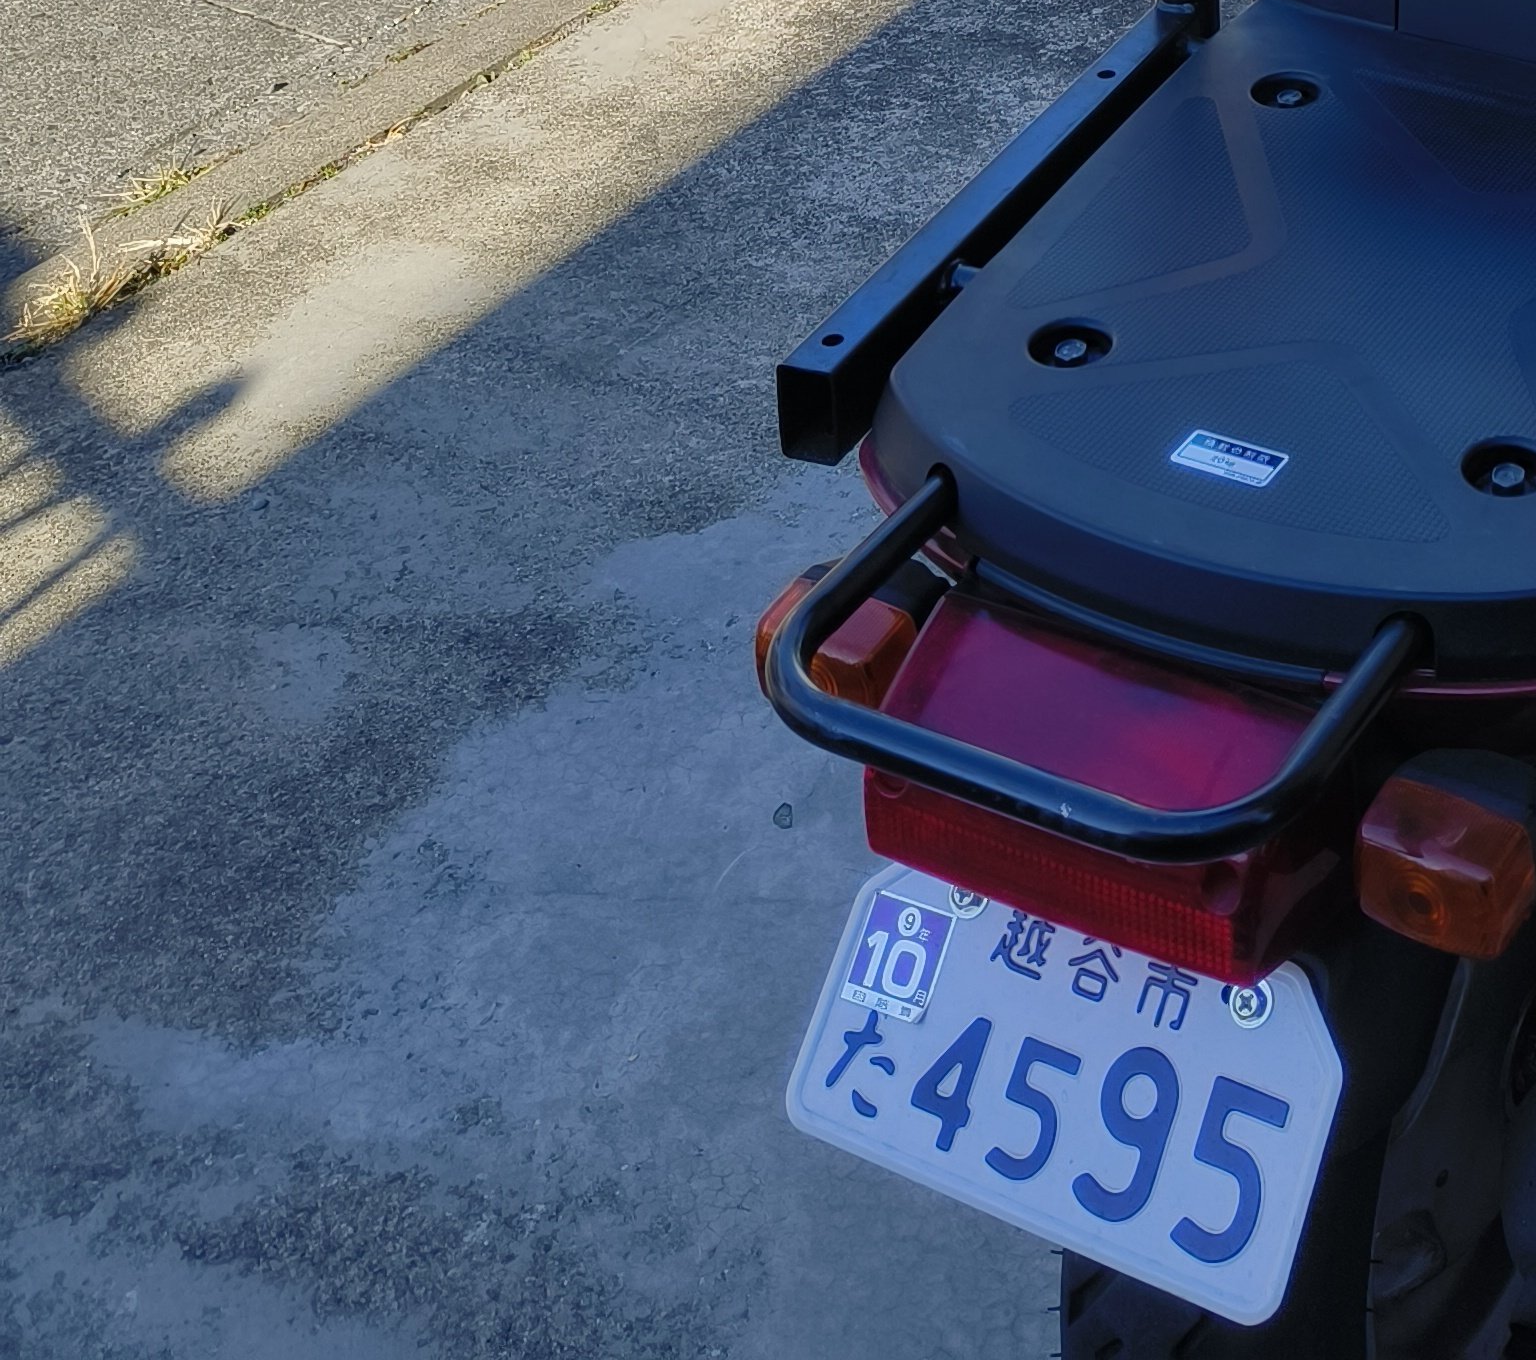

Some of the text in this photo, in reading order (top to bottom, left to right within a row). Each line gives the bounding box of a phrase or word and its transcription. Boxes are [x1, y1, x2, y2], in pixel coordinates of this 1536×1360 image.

[990, 908, 1198, 1031] 越谷市
[825, 1009, 1291, 1264] た 4595
